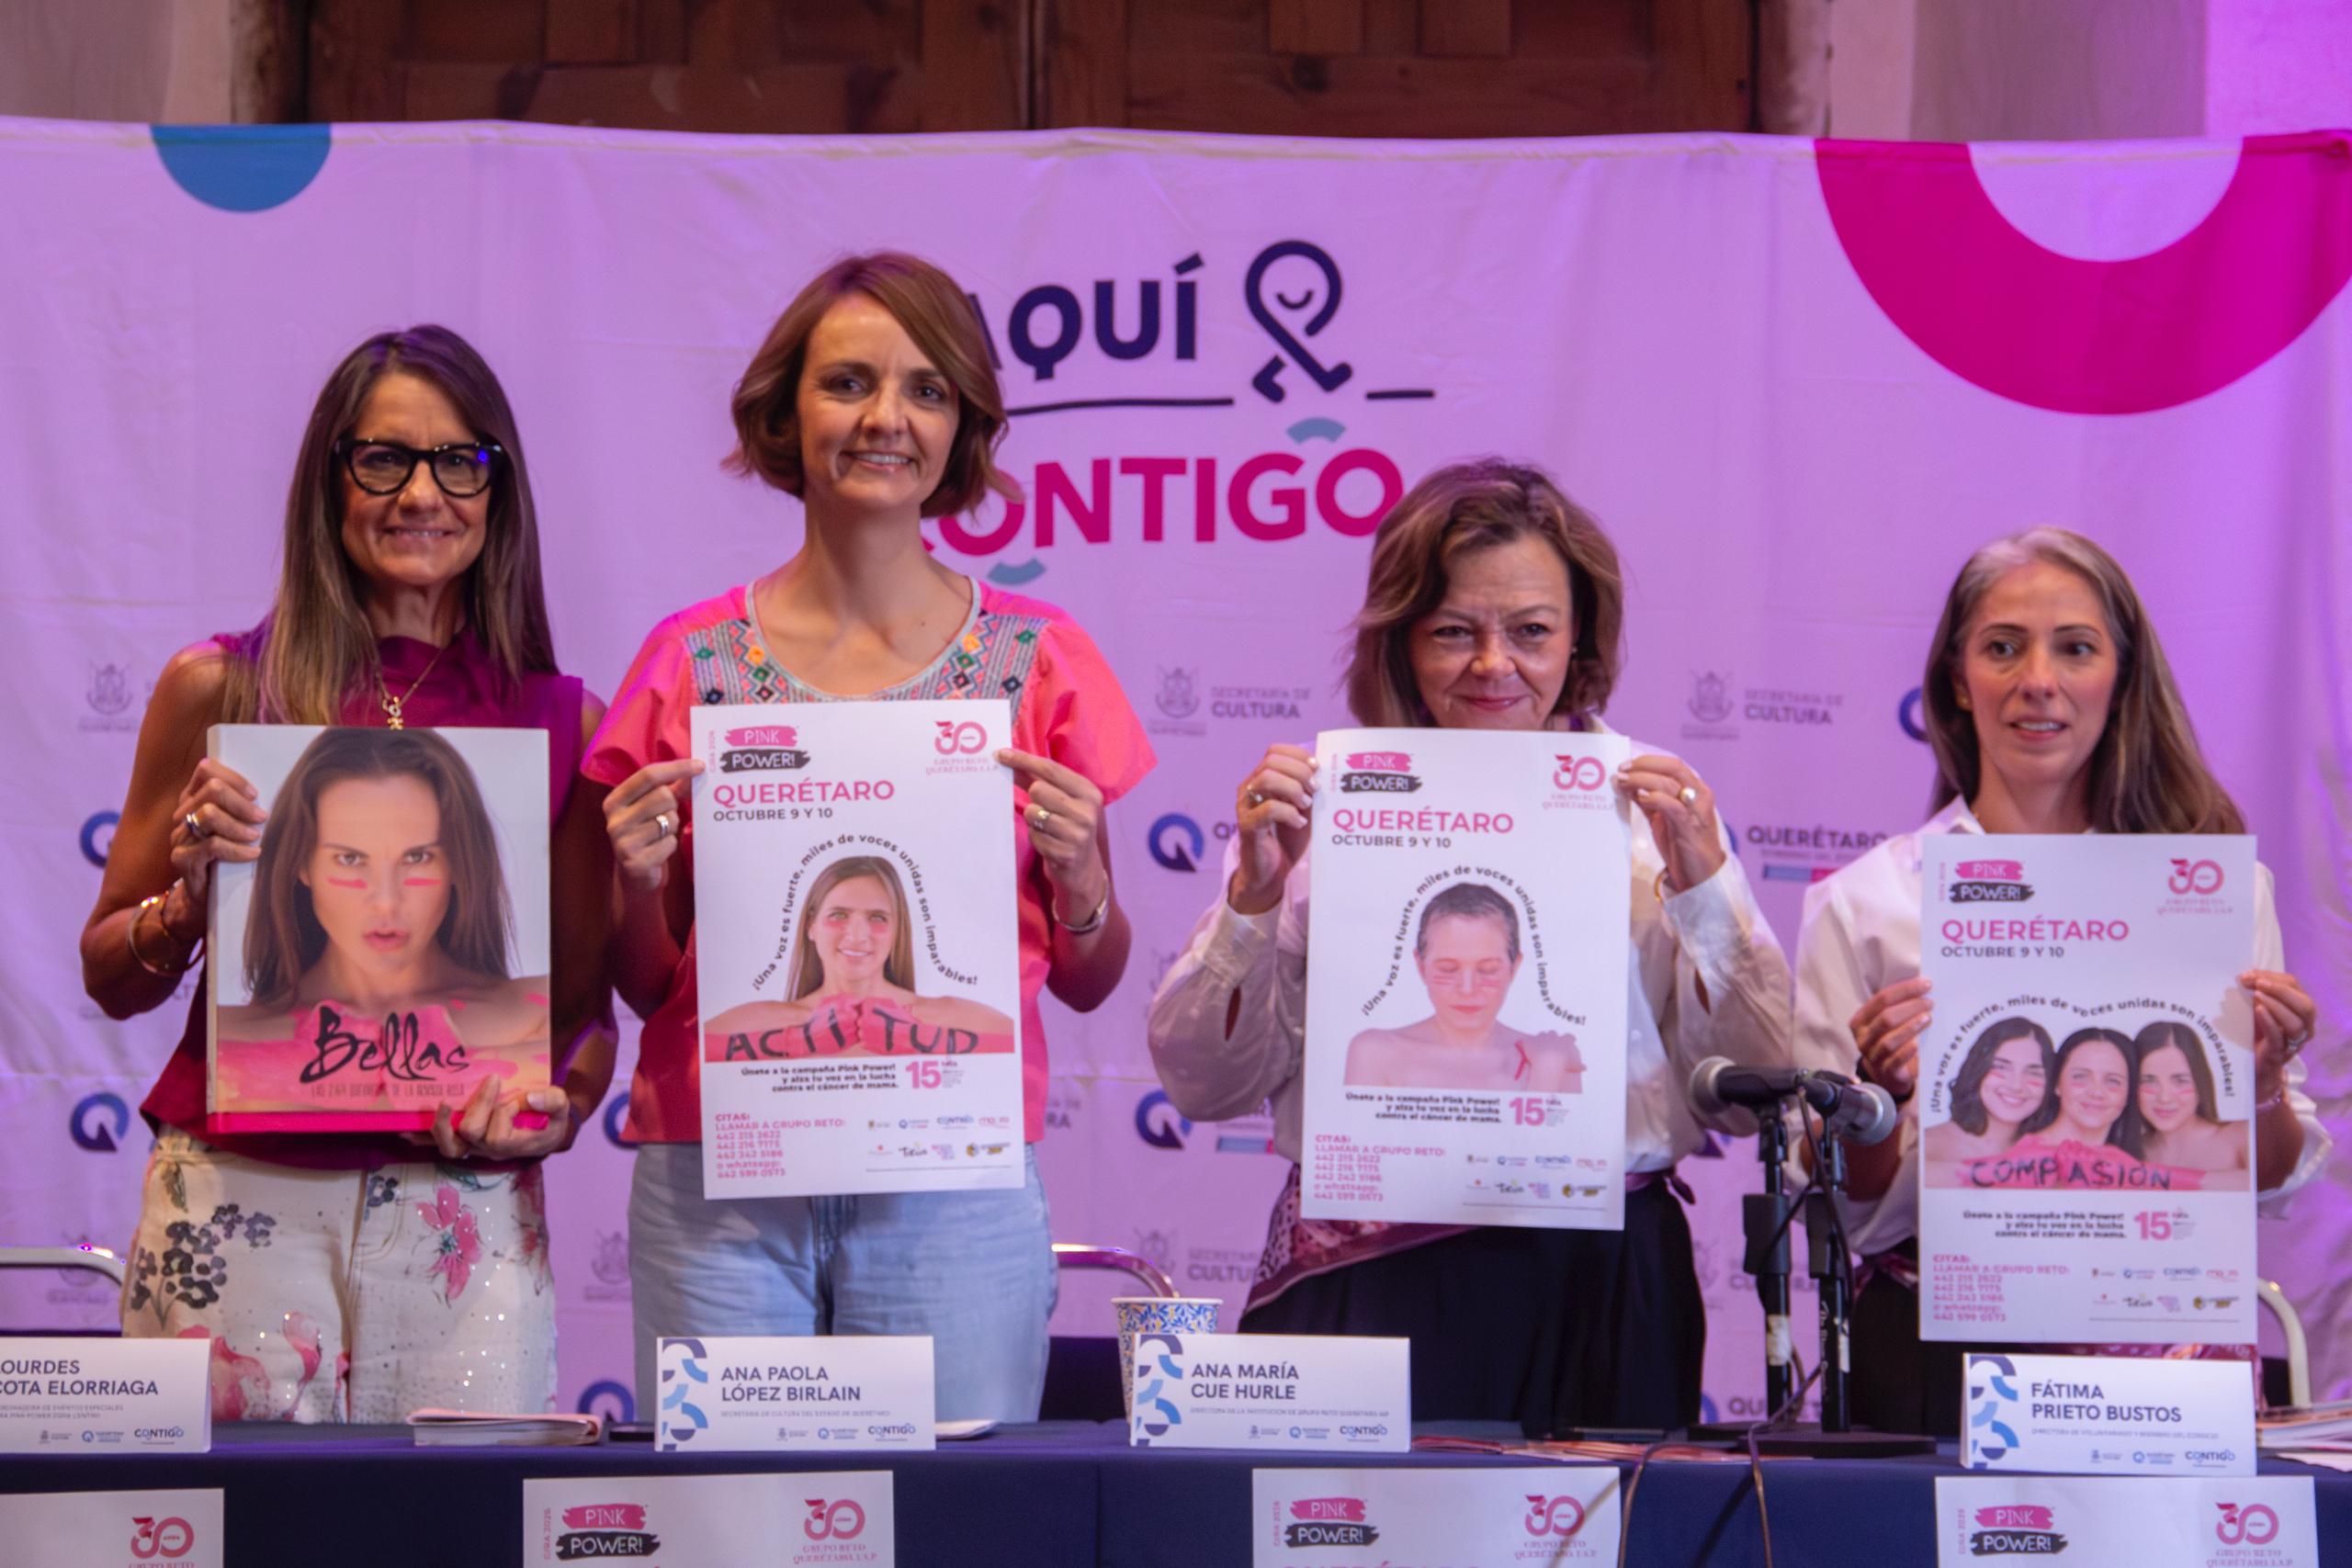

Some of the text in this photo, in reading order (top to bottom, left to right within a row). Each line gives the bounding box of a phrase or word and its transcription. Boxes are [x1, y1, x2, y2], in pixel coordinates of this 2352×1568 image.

[922, 448, 1403, 556] ONTIGO
[1210, 701, 1301, 719] CULTURA
[1745, 705, 1833, 726] CULTURA
[744, 729, 780, 745] PINK
[933, 720, 988, 755] 30
[731, 752, 796, 769] POWER!
[1363, 754, 1396, 768] PINK
[1553, 754, 1606, 791] 30
[713, 777, 895, 808] QUERÉTARO
[1351, 775, 1408, 791] POWER!
[713, 807, 833, 821] OCTUBRE 9 Y 10
[1333, 806, 1514, 834] QUERÉTARO
[837, 833, 854, 845] de
[859, 834, 898, 852] voces
[1332, 834, 1452, 849] OCTUBRE 9 Y 10
[801, 840, 833, 866] miles
[899, 851, 923, 895] unidas
[1453, 865, 1472, 875] de
[1475, 866, 1514, 886] voces
[1973, 863, 2007, 877] PINK
[2168, 858, 2225, 896] 30
[783, 869, 806, 914] fuerte,
[1416, 869, 1451, 896] miles
[1960, 885, 2021, 901] POWER!
[919, 897, 932, 922] son
[1515, 886, 1539, 931] unidas
[782, 918, 791, 933] es
[1941, 915, 2130, 944] QUERÉTARO
[775, 936, 788, 960] voz
[925, 925, 978, 986] imparables!
[1393, 945, 1404, 961] es
[1532, 933, 1544, 959] son
[1941, 945, 2065, 958] OCTUBRE 9 Y 10
[1385, 964, 1400, 987] voz
[1537, 962, 1587, 1026] imparables!
[300, 1006, 470, 1084] Bellas
[1938, 1053, 1951, 1076] voz
[1950, 1035, 1963, 1050] es
[2007, 994, 2047, 1007] miles
[2051, 997, 2068, 1010] de
[2073, 1002, 2114, 1018] voces
[2117, 997, 2166, 1010] unidas
[2170, 1003, 2196, 1020] son
[2197, 1015, 2236, 1098] imparables!
[838, 1064, 859, 1073] Pink
[905, 1060, 942, 1089] 15
[716, 1112, 750, 1122] CITAS:
[1509, 1097, 1546, 1126] 15
[1315, 1134, 1351, 1144] CITAS:
[2133, 1211, 2171, 1240] 15
[0, 1359, 81, 1376] OURDES
[720, 1366, 830, 1382] ANA PAOLA
[1191, 1360, 1300, 1380] ANA MARÍA
[0, 1380, 159, 1395] OTA ELORRIAGA
[721, 1382, 861, 1402] LÓPEZ BIRLAIN
[1191, 1382, 1296, 1400] CUE HURLE
[2031, 1379, 2105, 1399] FÁTIMA
[2031, 1403, 2182, 1423] PRIETO BUSTOS
[134, 1426, 185, 1440] CONTIGO
[868, 1423, 917, 1438] CONTIGO
[1340, 1424, 1388, 1438] CONTIGO
[2185, 1450, 2236, 1463] CONTIGO
[584, 1508, 626, 1527] PINK
[804, 1498, 866, 1541] 30
[1311, 1502, 1348, 1519] PINK
[1525, 1495, 1586, 1537] 30
[1996, 1509, 2034, 1526] PINK
[2215, 1503, 2279, 1545] 30
[130, 1517, 195, 1560] 30
[570, 1536, 643, 1555] POWER!
[1297, 1527, 1363, 1544] POWER!
[1983, 1535, 2052, 1551] POWER!
